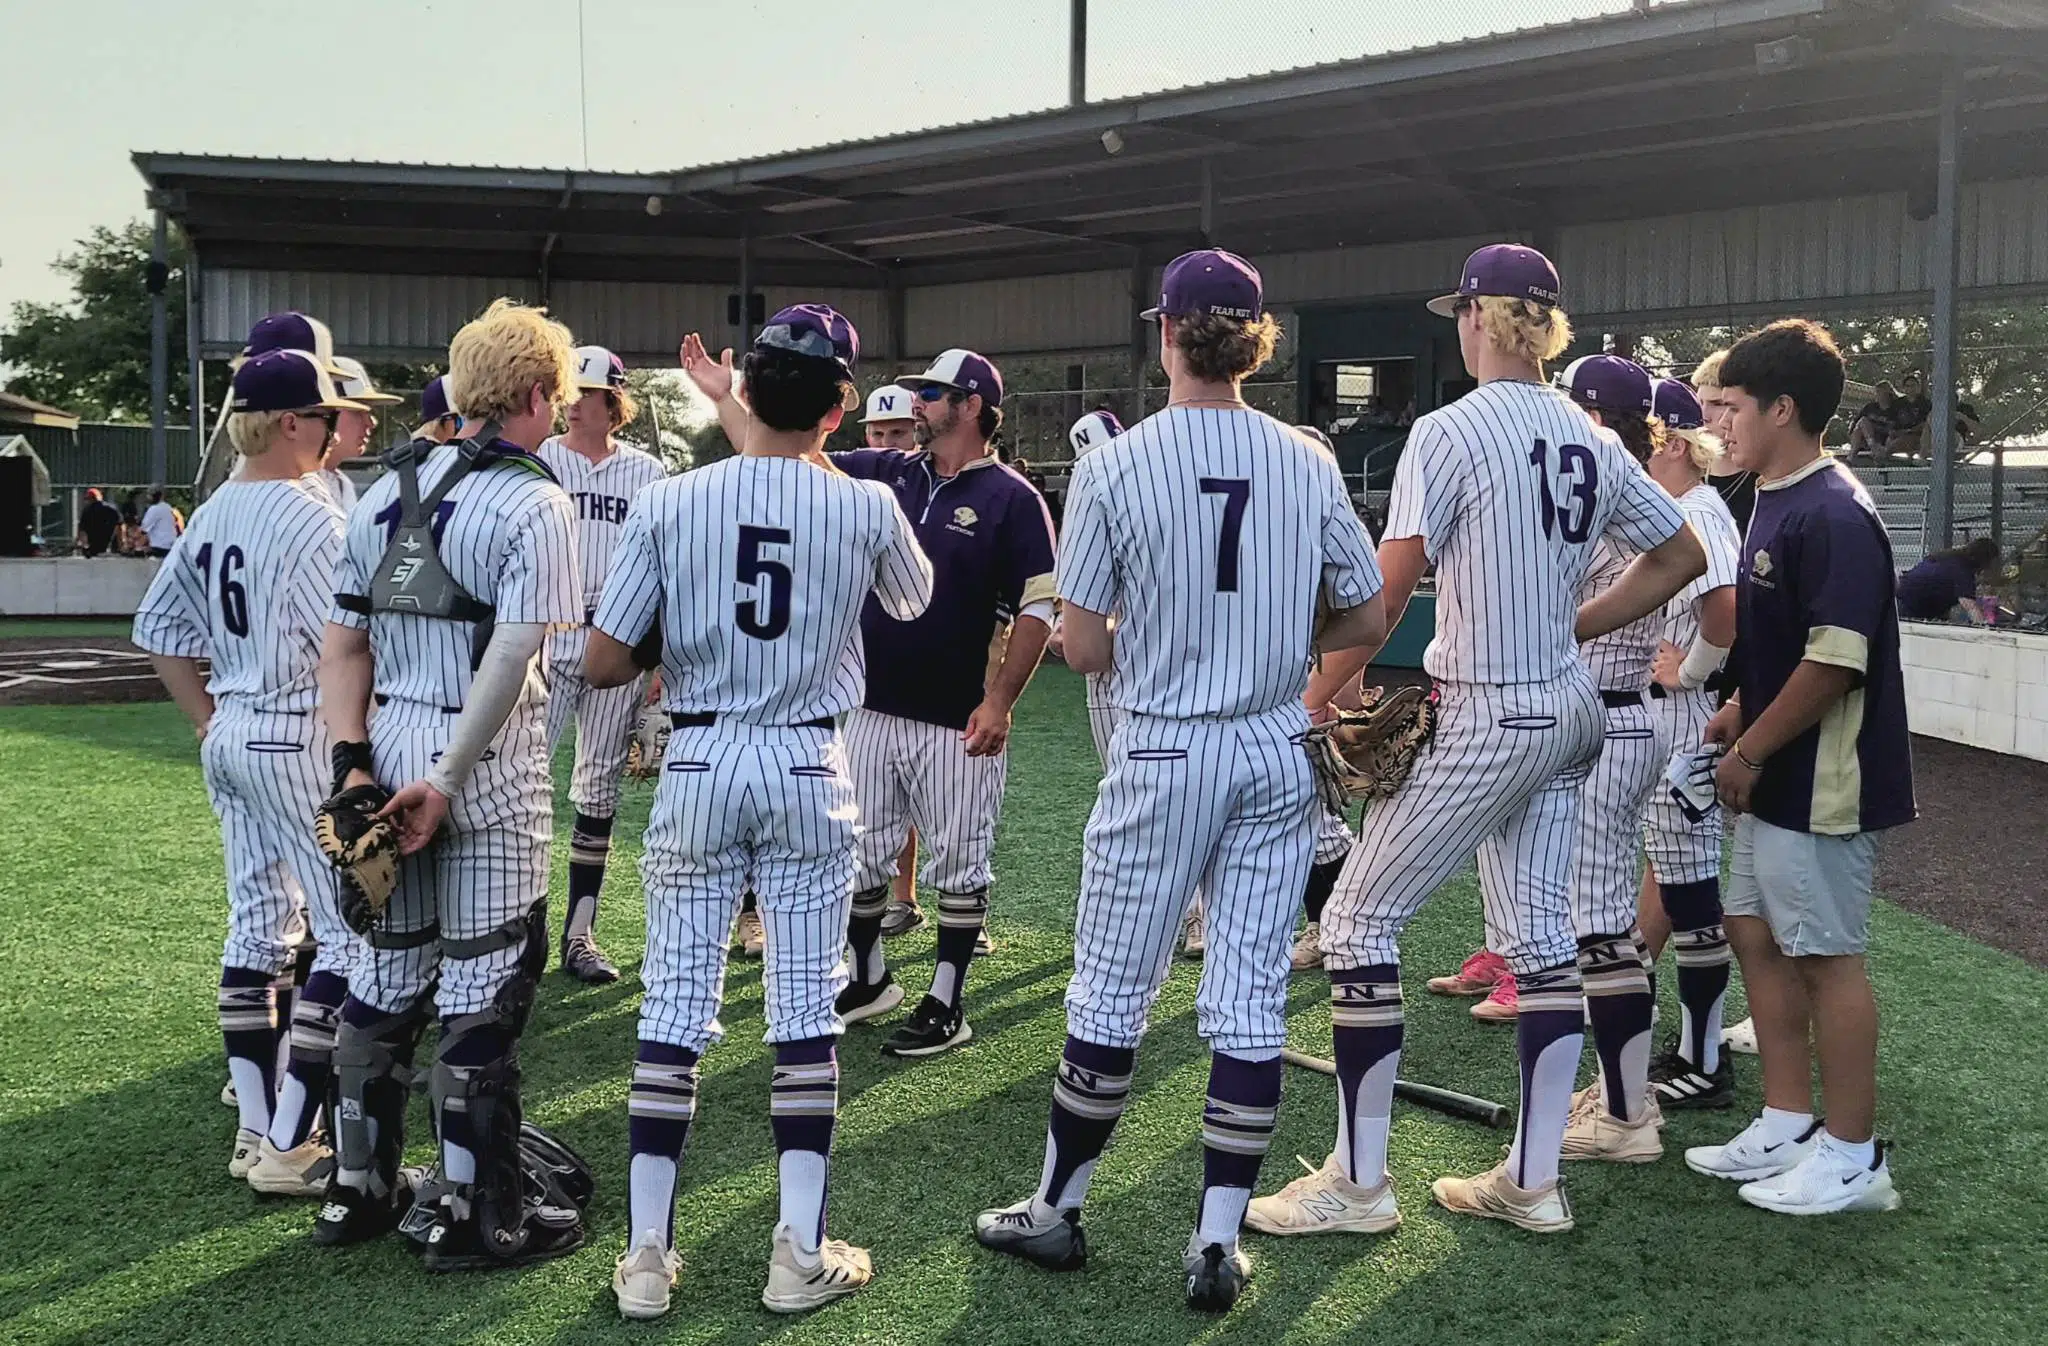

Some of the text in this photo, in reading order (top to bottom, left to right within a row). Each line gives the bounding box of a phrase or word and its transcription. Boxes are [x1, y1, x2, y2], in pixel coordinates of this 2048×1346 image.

[1210, 305, 1234, 317] FEAR
[878, 396, 895, 411] N
[1075, 428, 1091, 448] N
[1529, 438, 1598, 544] 13
[570, 491, 629, 526] THER
[1199, 477, 1250, 592] 7
[195, 542, 249, 639] 16
[735, 524, 792, 641] 5
[1690, 927, 1721, 944] N
[1584, 941, 1619, 965] N
[1341, 984, 1378, 999] N
[1064, 1063, 1104, 1091] N
[1299, 1189, 1347, 1222] N
